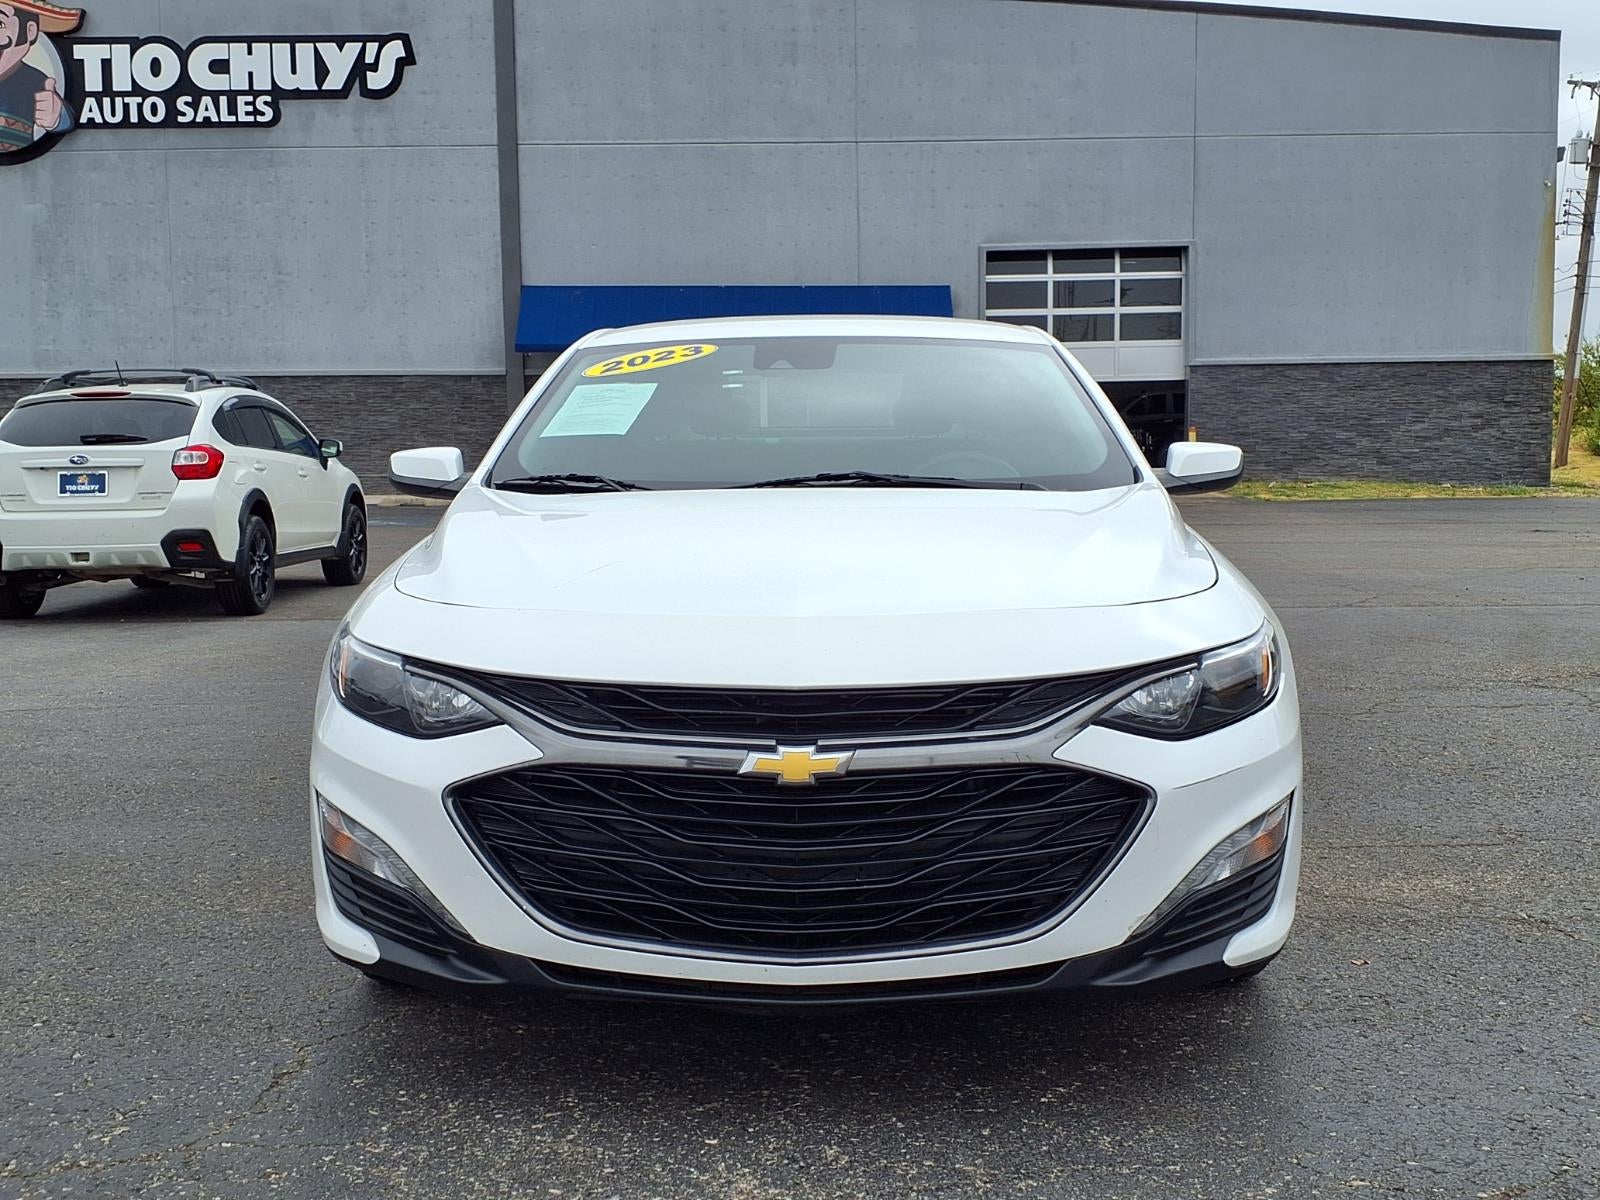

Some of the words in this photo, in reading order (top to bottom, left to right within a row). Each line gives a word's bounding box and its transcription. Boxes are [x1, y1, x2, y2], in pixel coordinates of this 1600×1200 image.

[73, 43, 181, 92] TIO
[188, 39, 406, 91] CHUY'S
[79, 97, 166, 123] AUTO
[177, 95, 274, 123] SALES
[599, 345, 704, 374] 2023
